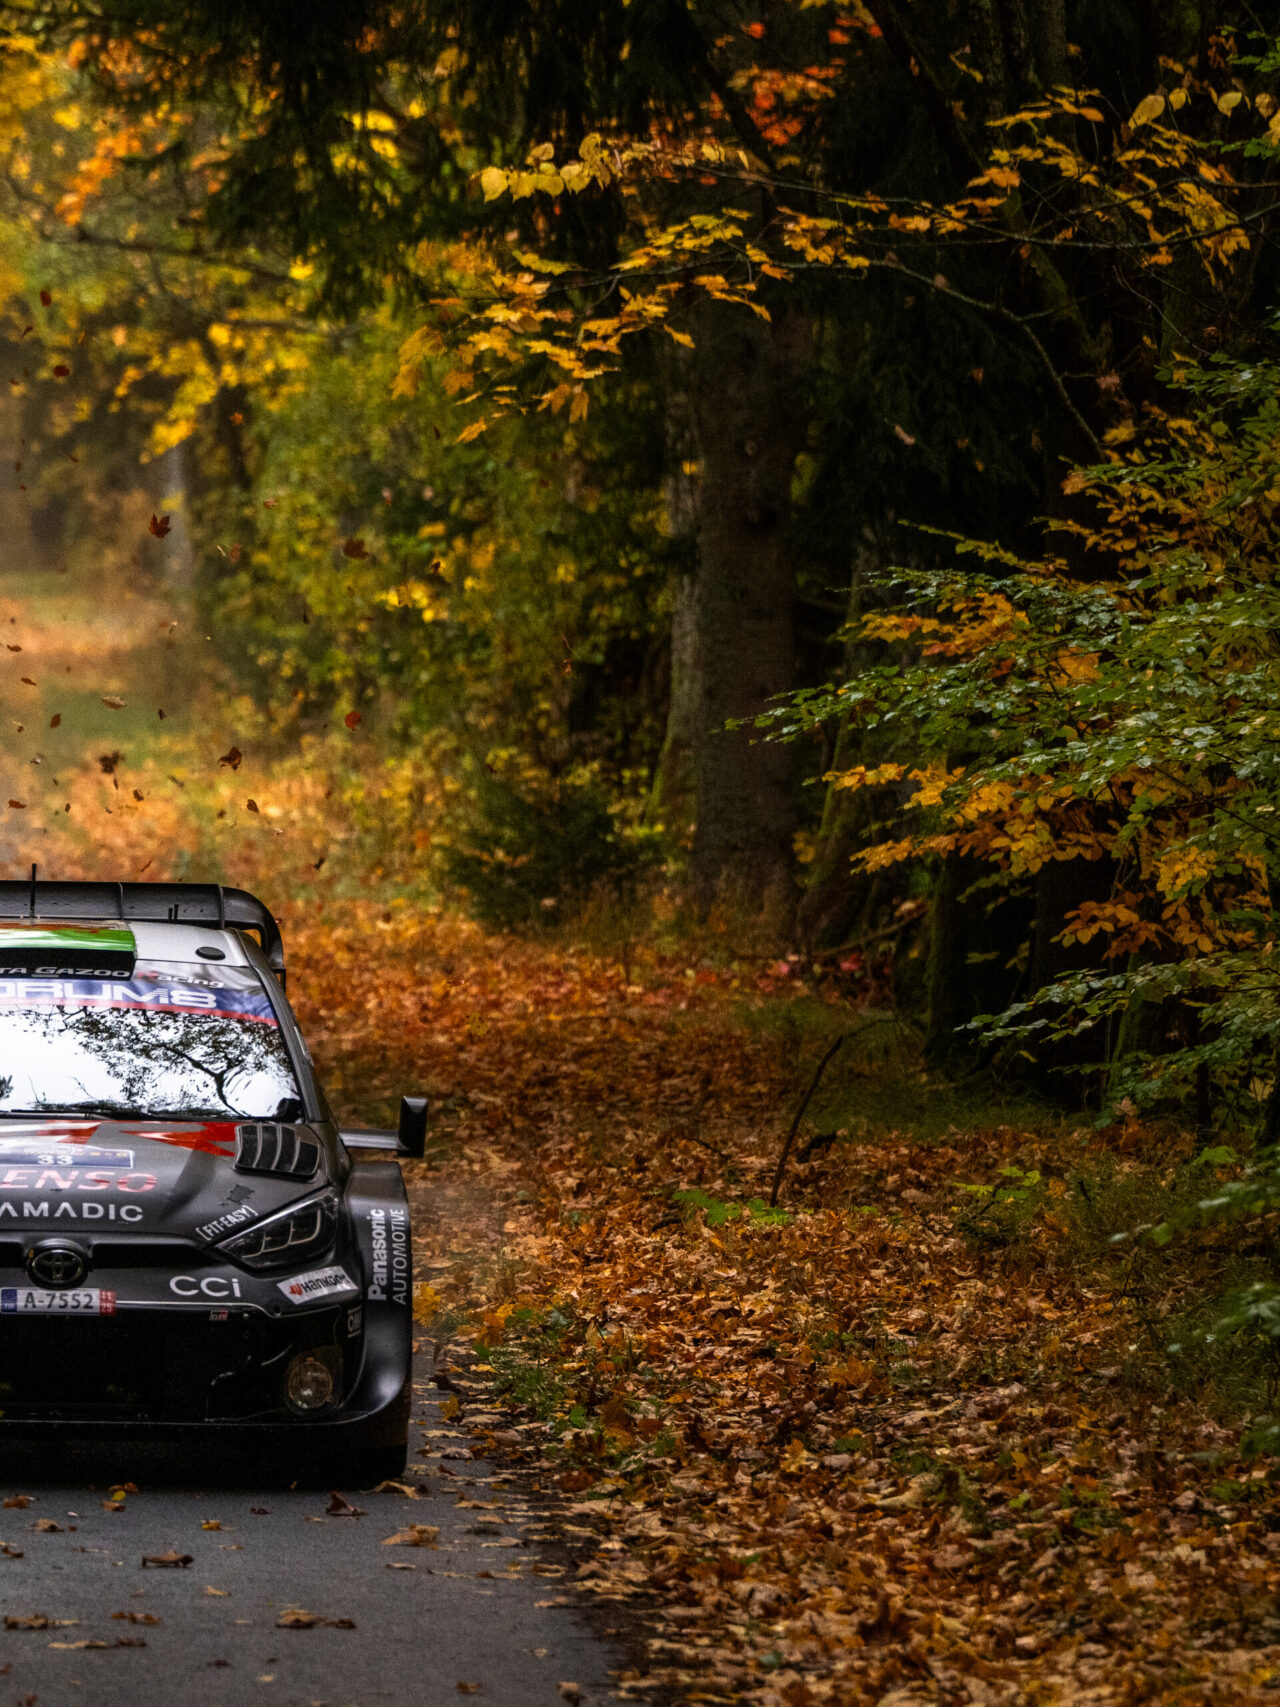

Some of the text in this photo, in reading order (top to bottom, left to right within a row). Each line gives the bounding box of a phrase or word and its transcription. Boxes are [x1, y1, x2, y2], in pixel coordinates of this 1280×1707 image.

[34, 966, 131, 978] GAZOO
[37, 1154, 74, 1166] 33
[366, 1208, 387, 1300] Panasonic
[390, 1208, 407, 1305] AUTOMOTIVE
[23, 1291, 94, 1309] A-7552
